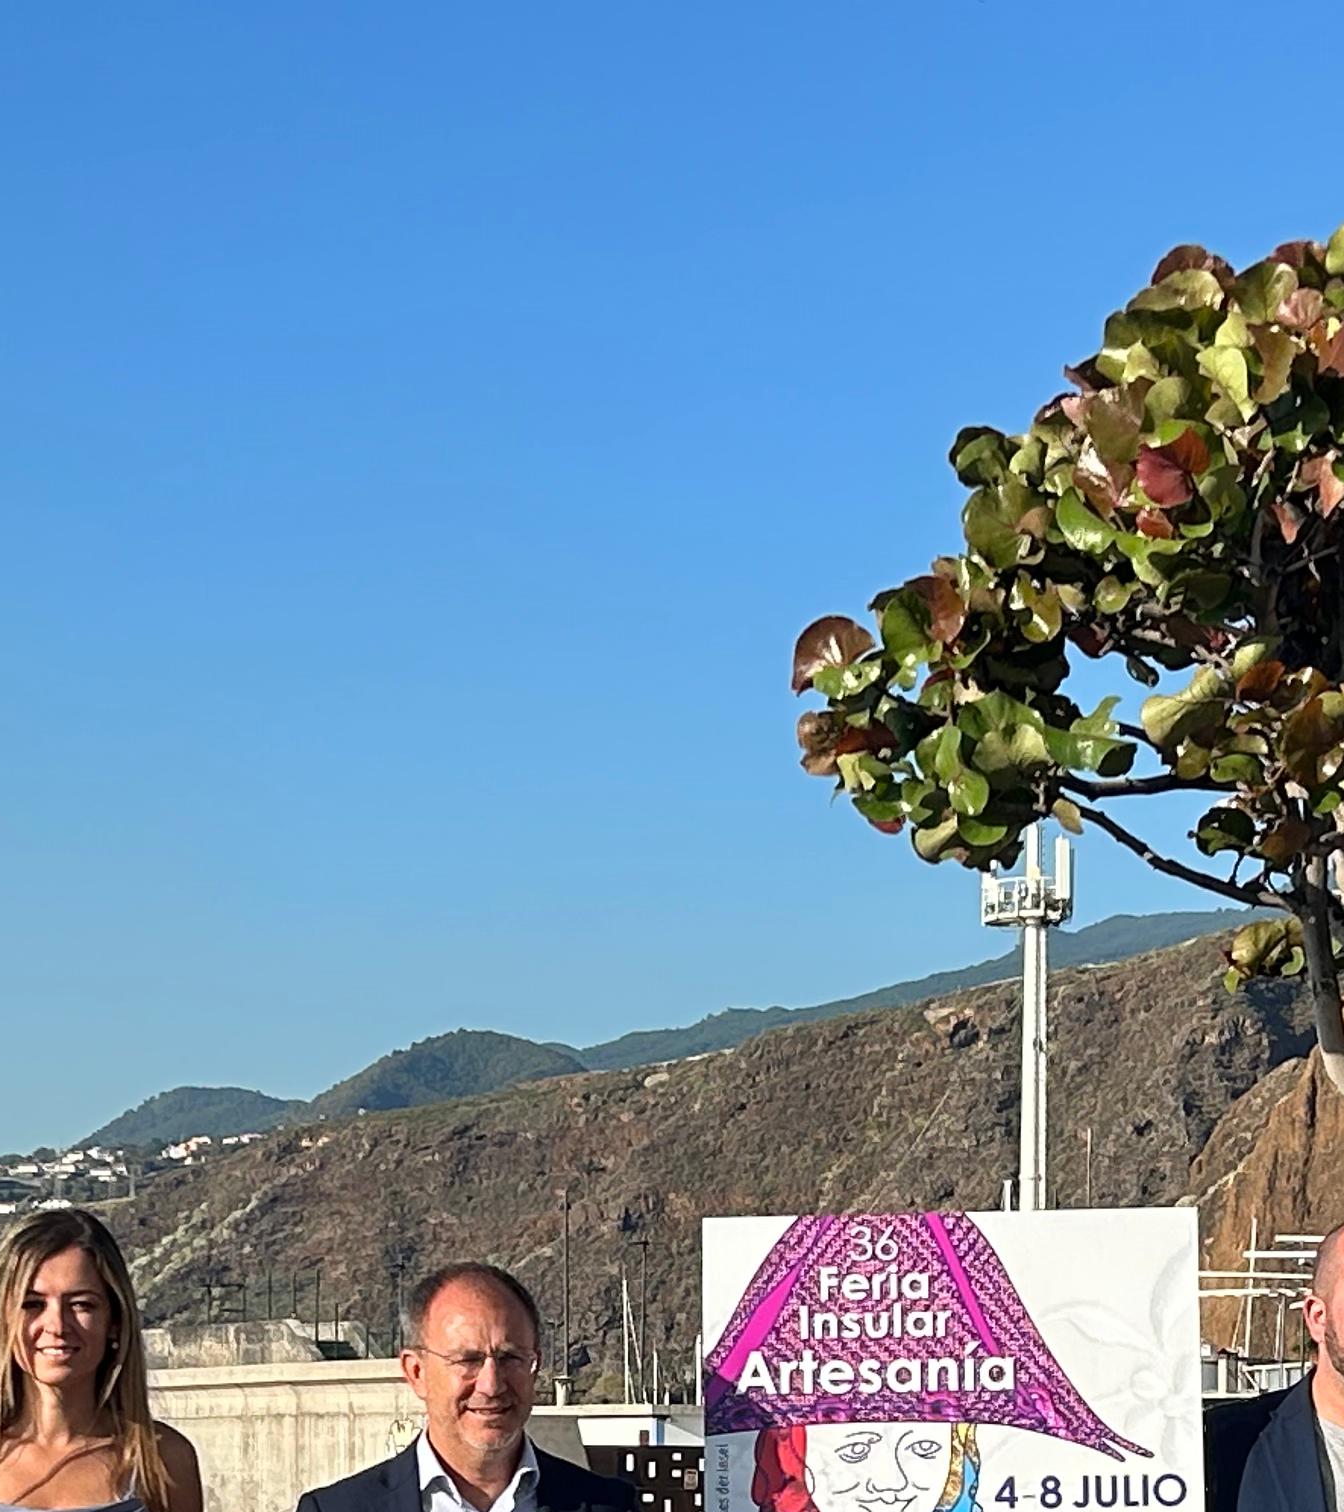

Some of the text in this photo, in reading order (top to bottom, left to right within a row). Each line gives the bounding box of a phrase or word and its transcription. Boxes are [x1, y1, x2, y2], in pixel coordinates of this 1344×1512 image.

[849, 1225, 898, 1261] 36
[819, 1264, 929, 1302] Feria
[799, 1303, 952, 1340] Insular
[736, 1341, 1015, 1395] Artesanía
[716, 1476, 729, 1494] der
[1072, 1474, 1187, 1508] JULIO
